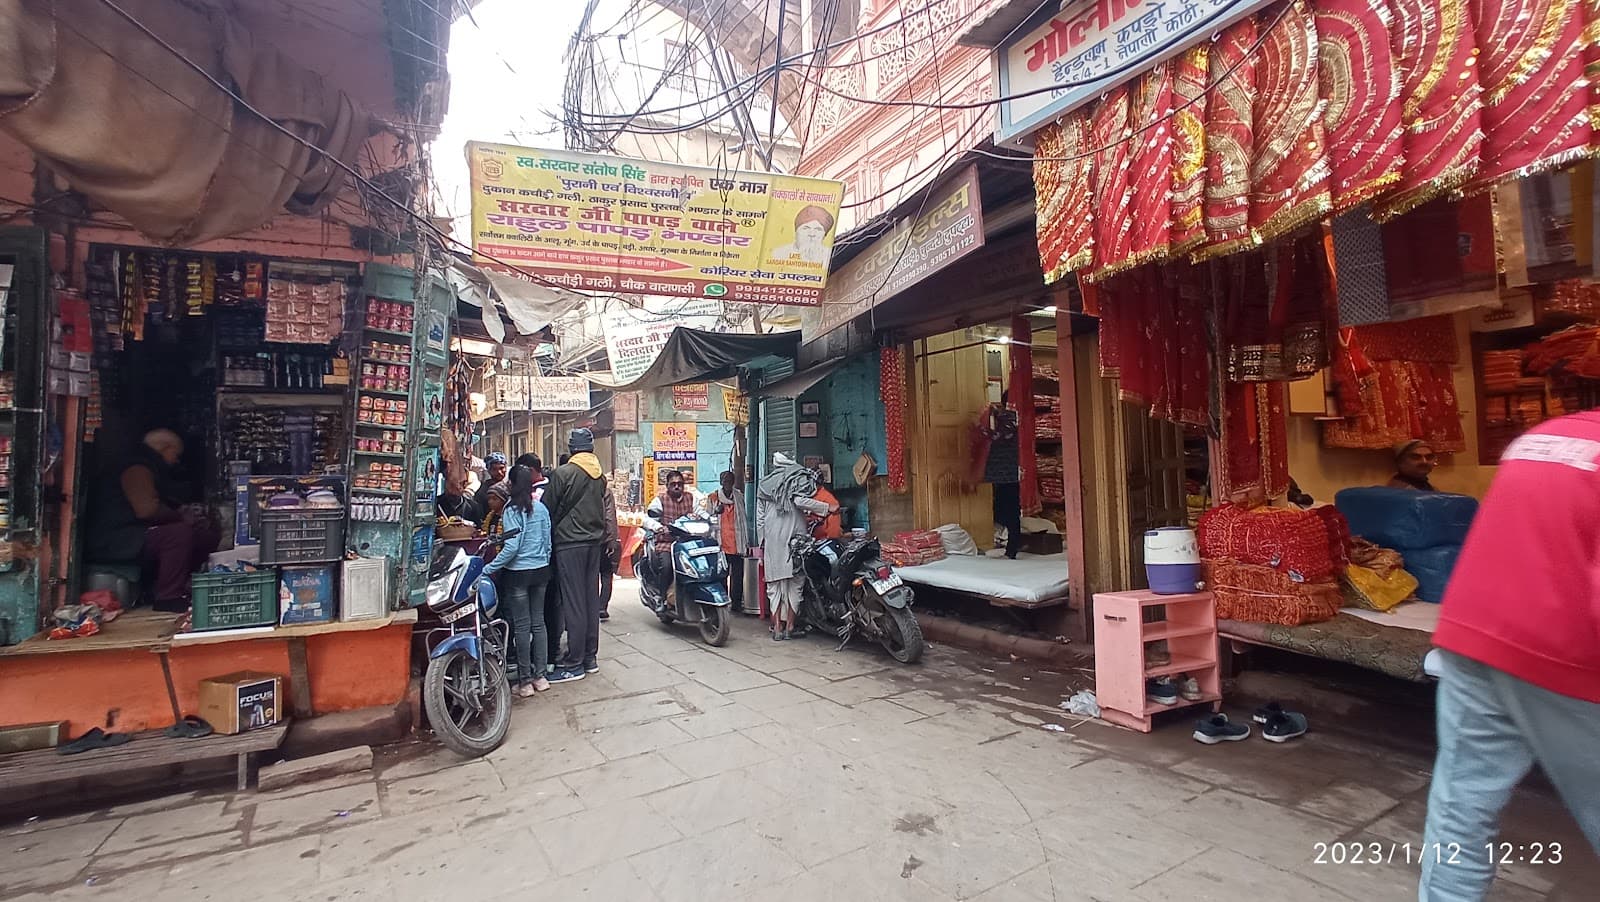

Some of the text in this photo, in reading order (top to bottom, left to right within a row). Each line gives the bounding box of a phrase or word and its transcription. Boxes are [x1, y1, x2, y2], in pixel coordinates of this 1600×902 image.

[583, 161, 617, 176] संतोष
[621, 163, 648, 181] सिंह
[650, 174, 669, 185] द्वारा
[709, 177, 736, 191] एक
[739, 181, 768, 195] मात्र
[482, 185, 515, 196] दुकान
[588, 196, 617, 208] ठाकुर
[618, 198, 648, 209] प्रसाद
[688, 206, 720, 216] भण्डार
[722, 208, 733, 216] के
[496, 199, 571, 218] सरदार
[578, 206, 614, 222] जी
[622, 211, 681, 230] पापड़
[690, 218, 740, 233] वाले
[486, 213, 752, 247] राहुल पापड़ भण्डार
[649, 279, 696, 294] वाराणसी
[750, 269, 775, 279] सेवा
[778, 272, 822, 283] उपलब्ध
[735, 284, 819, 297] 9984120080
[240, 690, 273, 705] FOCUS
